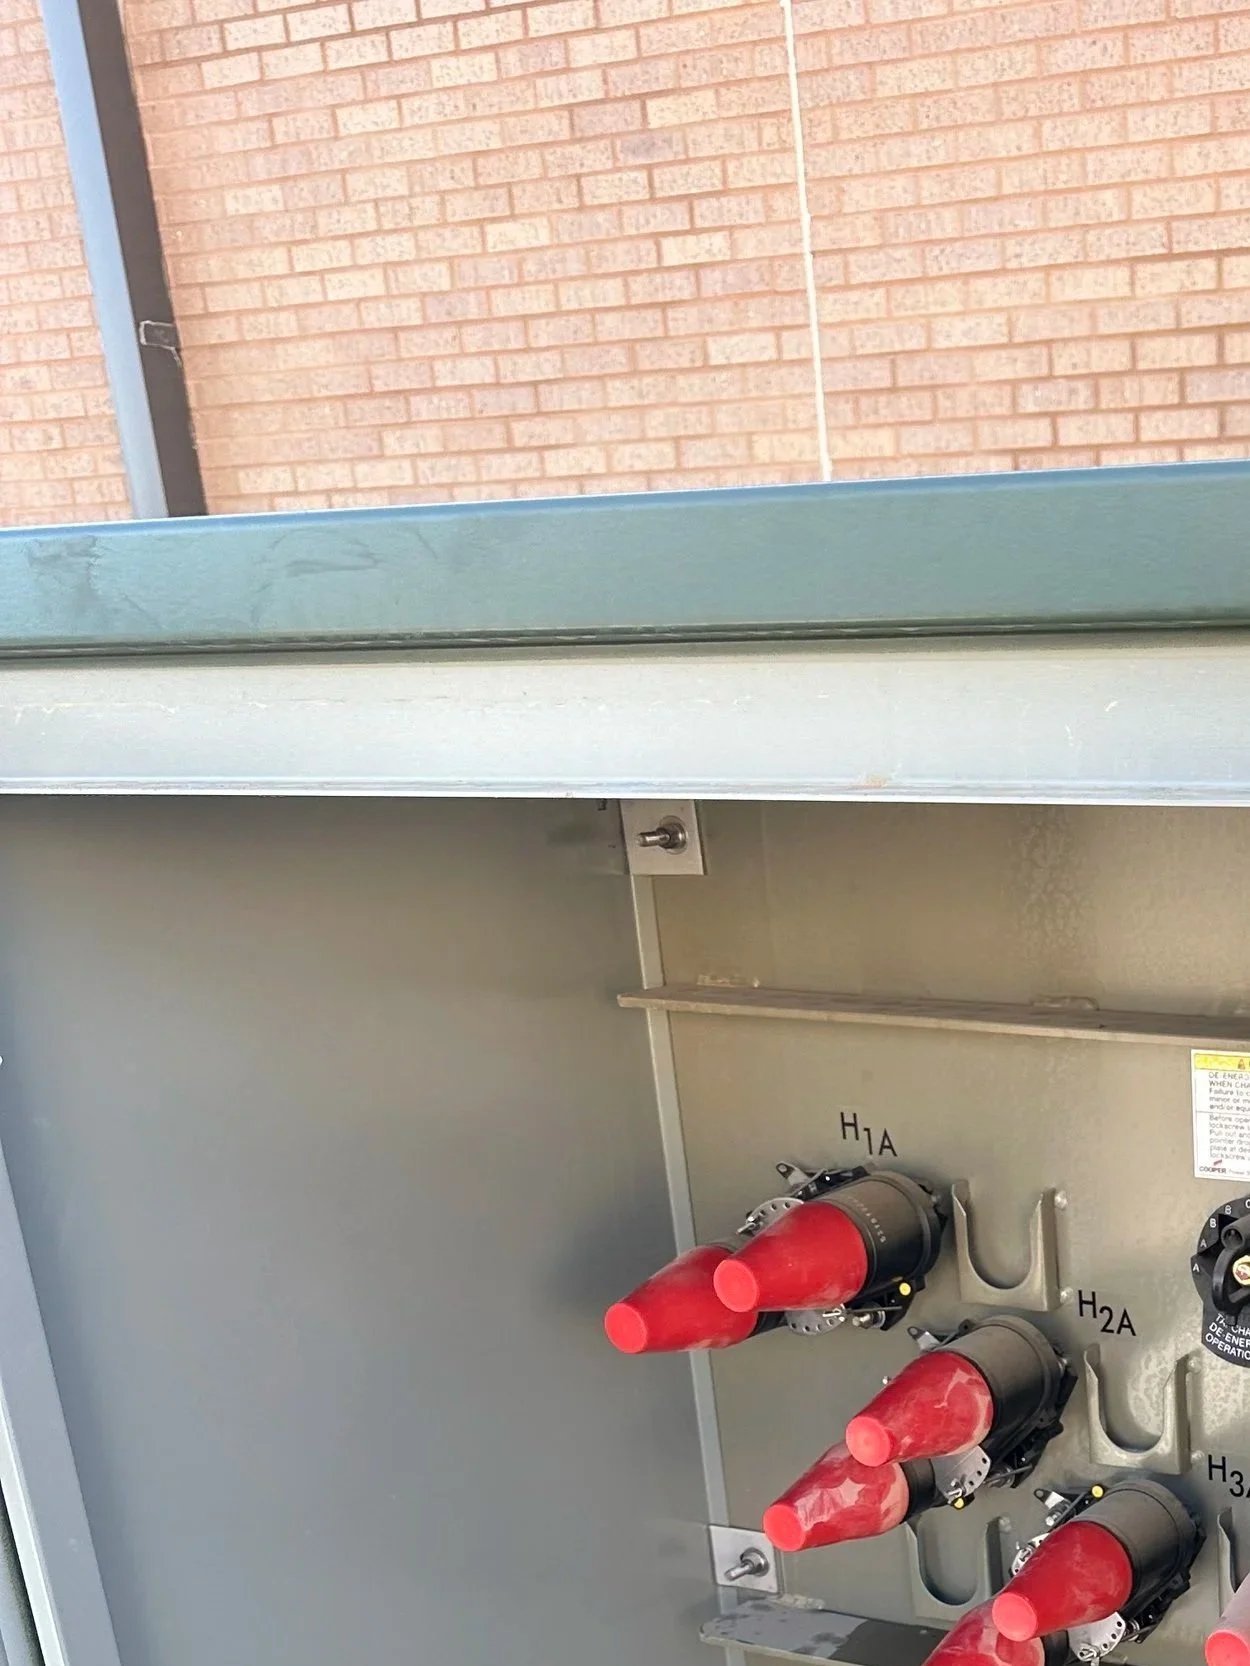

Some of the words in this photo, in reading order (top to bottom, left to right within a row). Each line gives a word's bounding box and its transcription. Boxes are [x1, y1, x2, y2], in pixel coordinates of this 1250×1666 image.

[1209, 1088, 1234, 1096] Failure
[840, 1111, 898, 1157] H1A
[1199, 1166, 1226, 1174] COOPER
[1225, 1205, 1232, 1214] B
[1210, 1218, 1216, 1227] B
[1200, 1239, 1207, 1247] A
[1193, 1264, 1199, 1272] A
[1078, 1289, 1137, 1337] H2A
